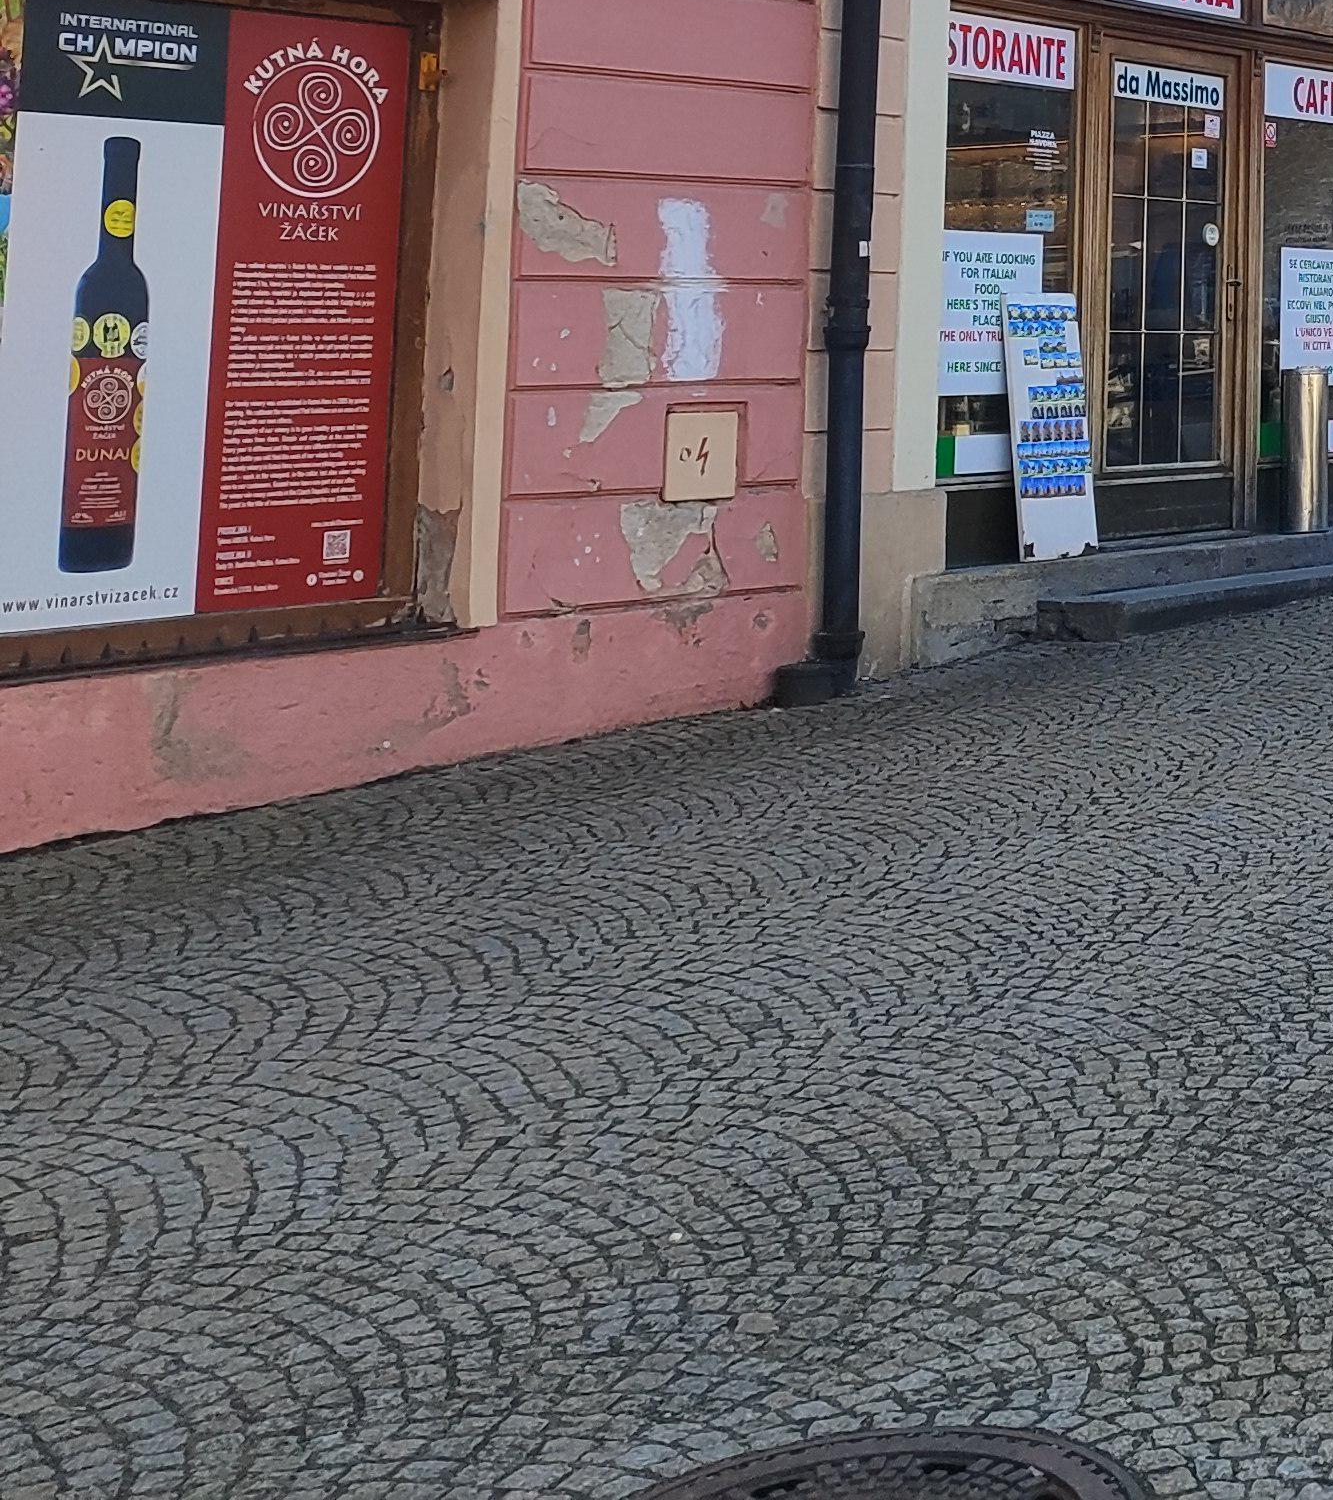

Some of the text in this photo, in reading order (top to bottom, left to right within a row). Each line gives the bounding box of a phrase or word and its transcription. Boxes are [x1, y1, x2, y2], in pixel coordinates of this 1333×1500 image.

[60, 12, 199, 39] INTERNATIONAL
[243, 37, 390, 105] KUTNÁ HORA
[1116, 65, 1221, 108] da Massimo
[258, 201, 363, 221] VINAŘSTVÍ
[279, 221, 340, 242] ŽÁČEK
[953, 251, 973, 263] YOU
[975, 252, 993, 264] ARE
[996, 253, 1036, 266] LOOKING
[961, 267, 1017, 280] FOR ITALIAN
[946, 299, 1000, 311] HERE'S THE
[973, 314, 1001, 326] PLACE
[959, 330, 983, 342] ONLY
[947, 362, 1001, 373] HERE SINCE
[75, 448, 130, 462] DUNAJ
[3, 585, 179, 614] www.vinarstvizacek.cz
